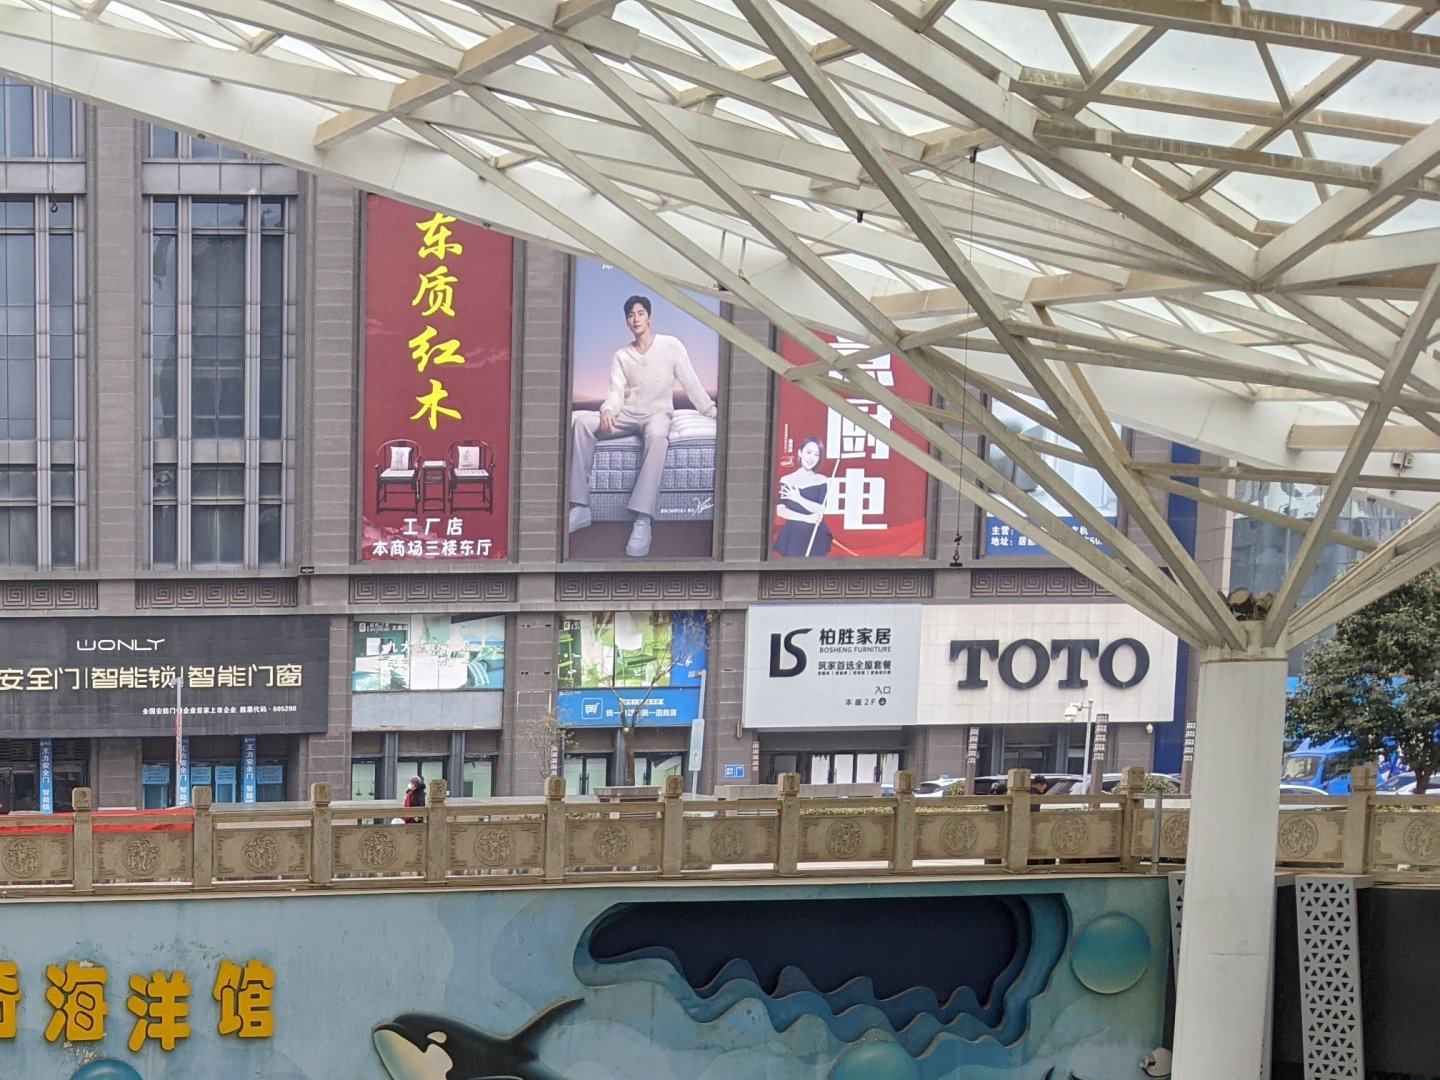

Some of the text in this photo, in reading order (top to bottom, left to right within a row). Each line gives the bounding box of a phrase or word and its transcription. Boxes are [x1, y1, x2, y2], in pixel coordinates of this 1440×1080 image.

[408, 212, 465, 430] 东质红木
[402, 517, 463, 536] 工厂店
[372, 539, 493, 557] 本商场三楼东厅
[819, 628, 891, 645] 柏胜家居
[949, 637, 1151, 690] TOTO
[188, 664, 302, 687] 智能门窗
[874, 686, 891, 694] 入口
